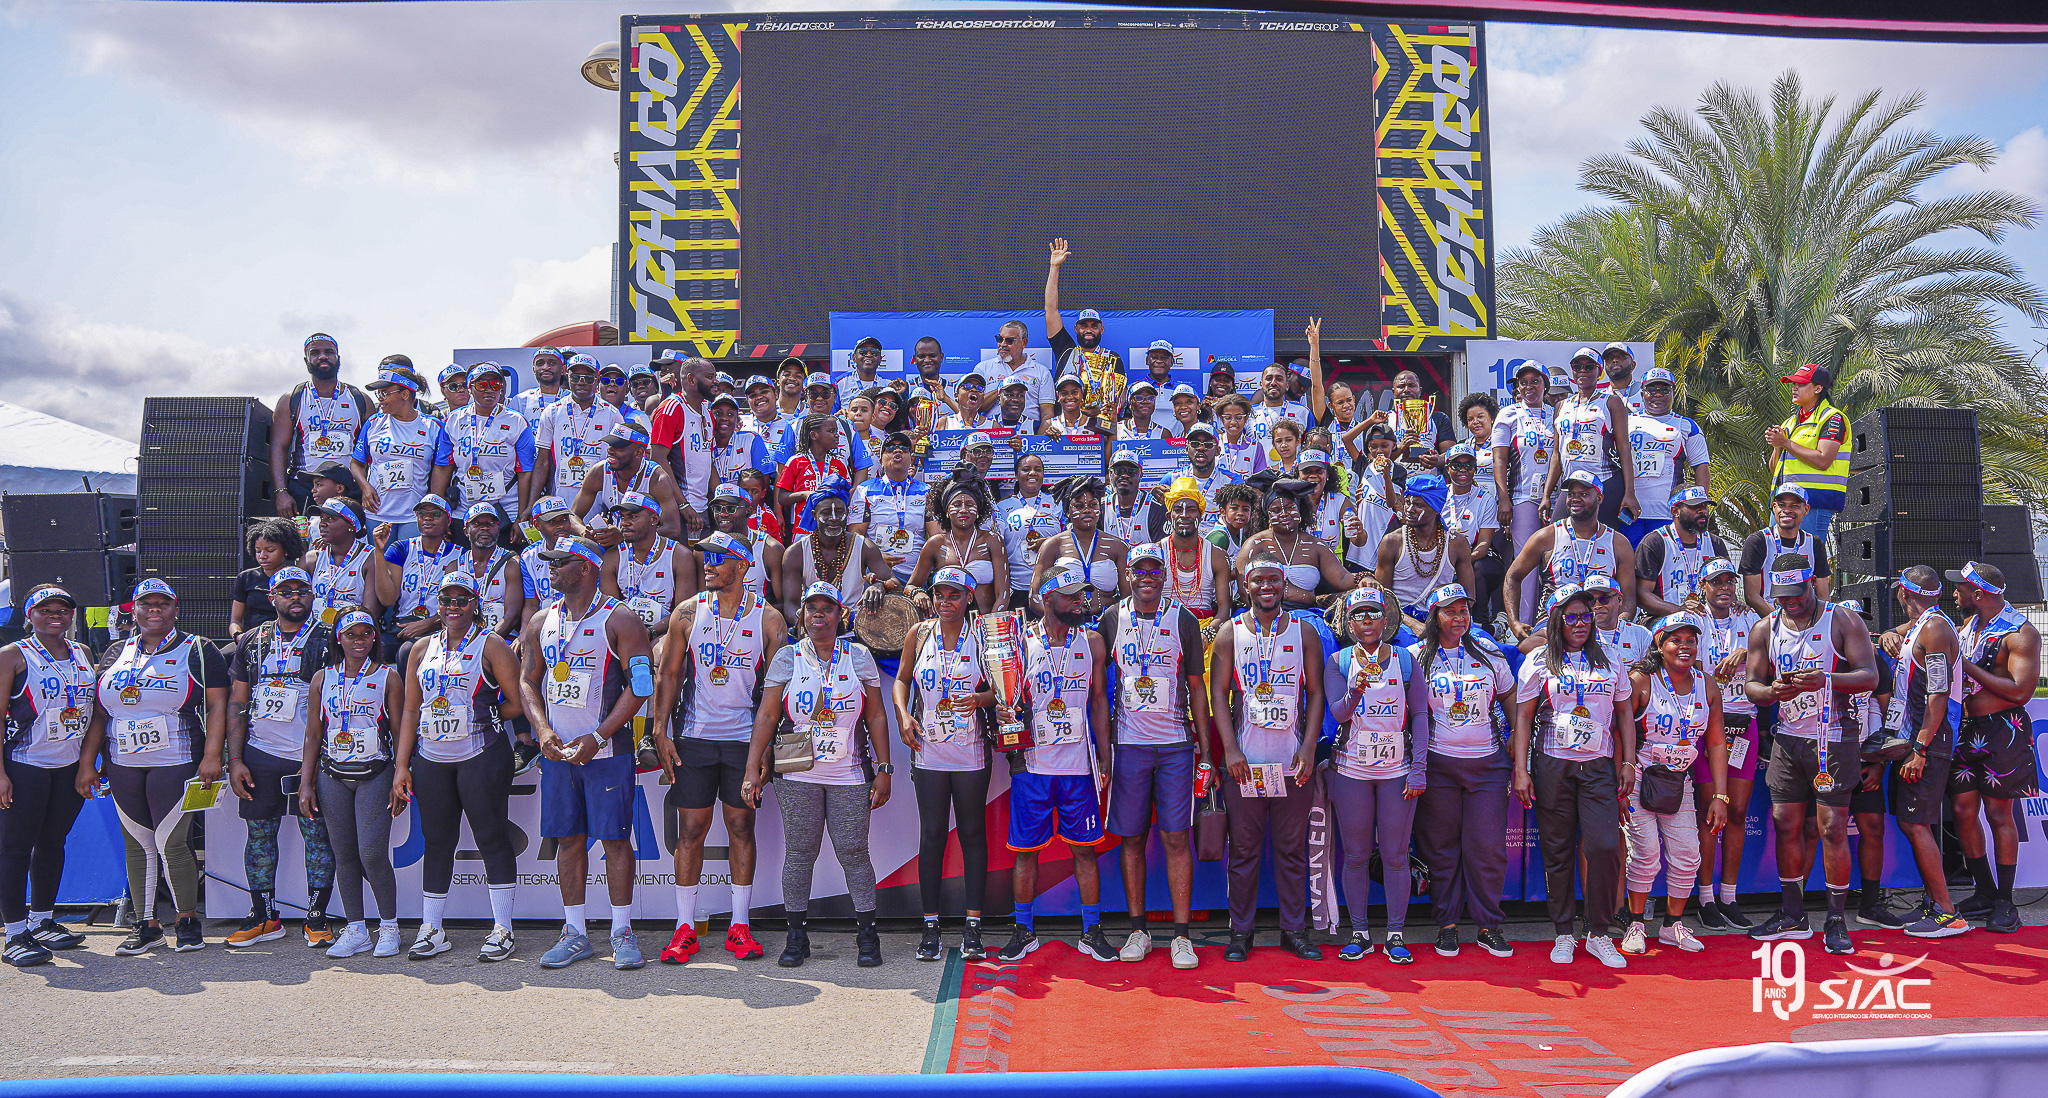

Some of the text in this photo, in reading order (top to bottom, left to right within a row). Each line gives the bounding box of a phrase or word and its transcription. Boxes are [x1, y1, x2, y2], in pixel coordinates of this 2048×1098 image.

[915, 20, 1056, 30] TCHACOSPORT.COM
[636, 42, 678, 339] TCHACO
[1431, 44, 1476, 333] TCHACO
[1234, 382, 1258, 390] SIAC
[375, 436, 424, 457] 19 SIAC
[458, 435, 472, 456] 19
[561, 436, 574, 456] 19
[1523, 431, 1538, 447] 19
[1629, 433, 1675, 452] 19 SIAC
[1408, 463, 1426, 471] 255
[1636, 460, 1657, 472] 121
[389, 470, 405, 483] 24
[479, 482, 495, 495] 26
[552, 500, 566, 508] SIAC
[1366, 494, 1389, 509] SIAC
[1008, 513, 1054, 532] 19 SIAC
[1143, 548, 1158, 556] SIAC
[1559, 559, 1575, 578] 19
[1719, 562, 1733, 570] SIAC
[286, 570, 301, 579] SIAC
[454, 576, 469, 584] SIAC
[945, 572, 960, 580] SIAC
[1063, 572, 1072, 583] 19
[1781, 574, 1796, 583] SIAC
[151, 582, 167, 590] SIAC
[403, 573, 419, 592] 19
[818, 584, 834, 594] SIAC
[1362, 591, 1376, 600] SIAC
[1450, 587, 1464, 596] SIAC
[354, 615, 371, 623] SIAC
[543, 645, 596, 669] 19 SIAC
[698, 643, 752, 669] 19 SIAC
[1122, 643, 1138, 666] 19
[1777, 653, 1824, 672] 19 SIAC
[107, 669, 179, 690] 19 SIAC
[422, 669, 436, 692] 19
[920, 668, 936, 692] 19
[1036, 671, 1050, 694] 19
[1242, 662, 1258, 688] 19
[39, 677, 61, 700] 19
[557, 683, 581, 700] 133
[1431, 676, 1450, 698] 19
[1556, 674, 1574, 696] 19
[270, 690, 286, 698] SIAC
[265, 700, 284, 713] 99
[796, 690, 814, 714] 19
[1367, 704, 1398, 715] SIAC
[1792, 695, 1817, 711] 163
[1262, 706, 1288, 722] 105
[1886, 709, 1901, 723] 57
[128, 721, 135, 731] 19
[433, 719, 460, 734] 107
[1054, 721, 1072, 736] 78
[1577, 720, 1594, 730] SIAC
[1655, 713, 1673, 737] 19
[1724, 726, 1746, 735] ORTS
[131, 731, 160, 745] 103
[821, 730, 838, 738] SIAC
[1370, 732, 1394, 743] 19 SIAC
[1573, 729, 1592, 745] 79
[816, 740, 836, 755] 44
[1371, 744, 1396, 759] 141
[1666, 756, 1689, 769] 125
[2027, 798, 2048, 816] ANO
[1309, 806, 1327, 923] NAKED
[453, 874, 488, 885] SERVI
[516, 874, 561, 885] TEGRAD
[699, 874, 732, 885] CIDAD
